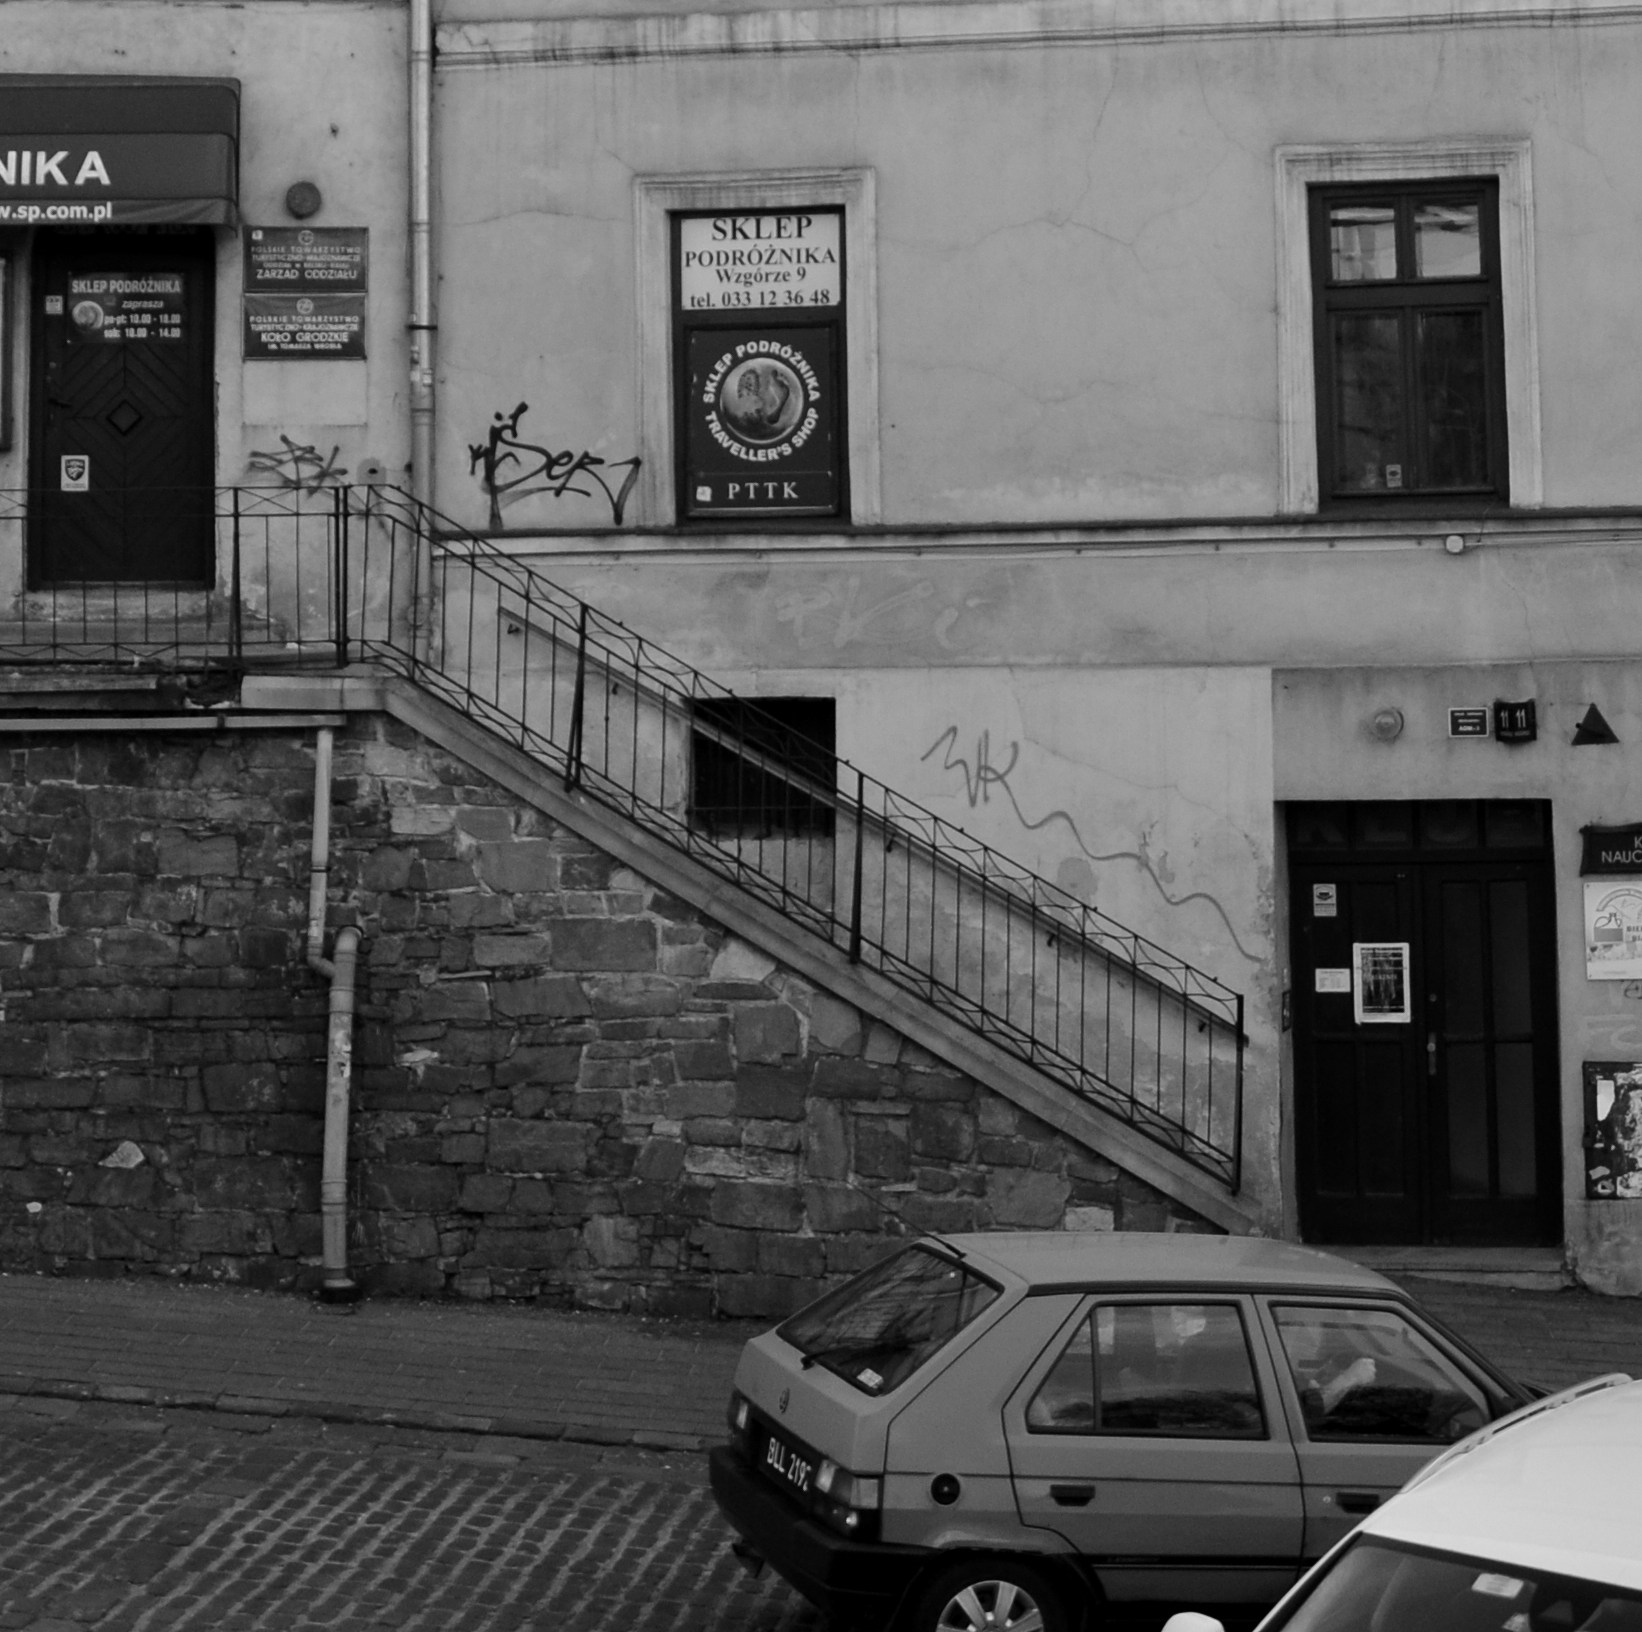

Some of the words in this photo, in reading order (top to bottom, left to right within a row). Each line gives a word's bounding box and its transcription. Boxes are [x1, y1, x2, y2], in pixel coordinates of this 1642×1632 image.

[712, 216, 812, 241] SKLEP
[684, 243, 837, 268] PODRÓŻNIKA
[72, 280, 108, 293] SKLEP
[109, 276, 181, 294] PODRÓŻNIKA
[715, 267, 791, 288] Wzgórze
[796, 266, 806, 282] 9
[690, 292, 716, 308] tel.
[721, 290, 752, 307] 033
[759, 290, 777, 306] 12
[783, 289, 804, 306] 36
[809, 288, 830, 304] 48
[261, 332, 291, 342] KOŁO
[296, 332, 349, 342] GRODZKIE
[703, 353, 732, 403] SKLEP
[735, 340, 821, 402] PODRÓŻNIKA
[705, 410, 792, 462] TRAVELLER'S
[791, 407, 819, 448] SHOP
[728, 481, 799, 500] PTTK
[767, 1437, 785, 1473] BLL
